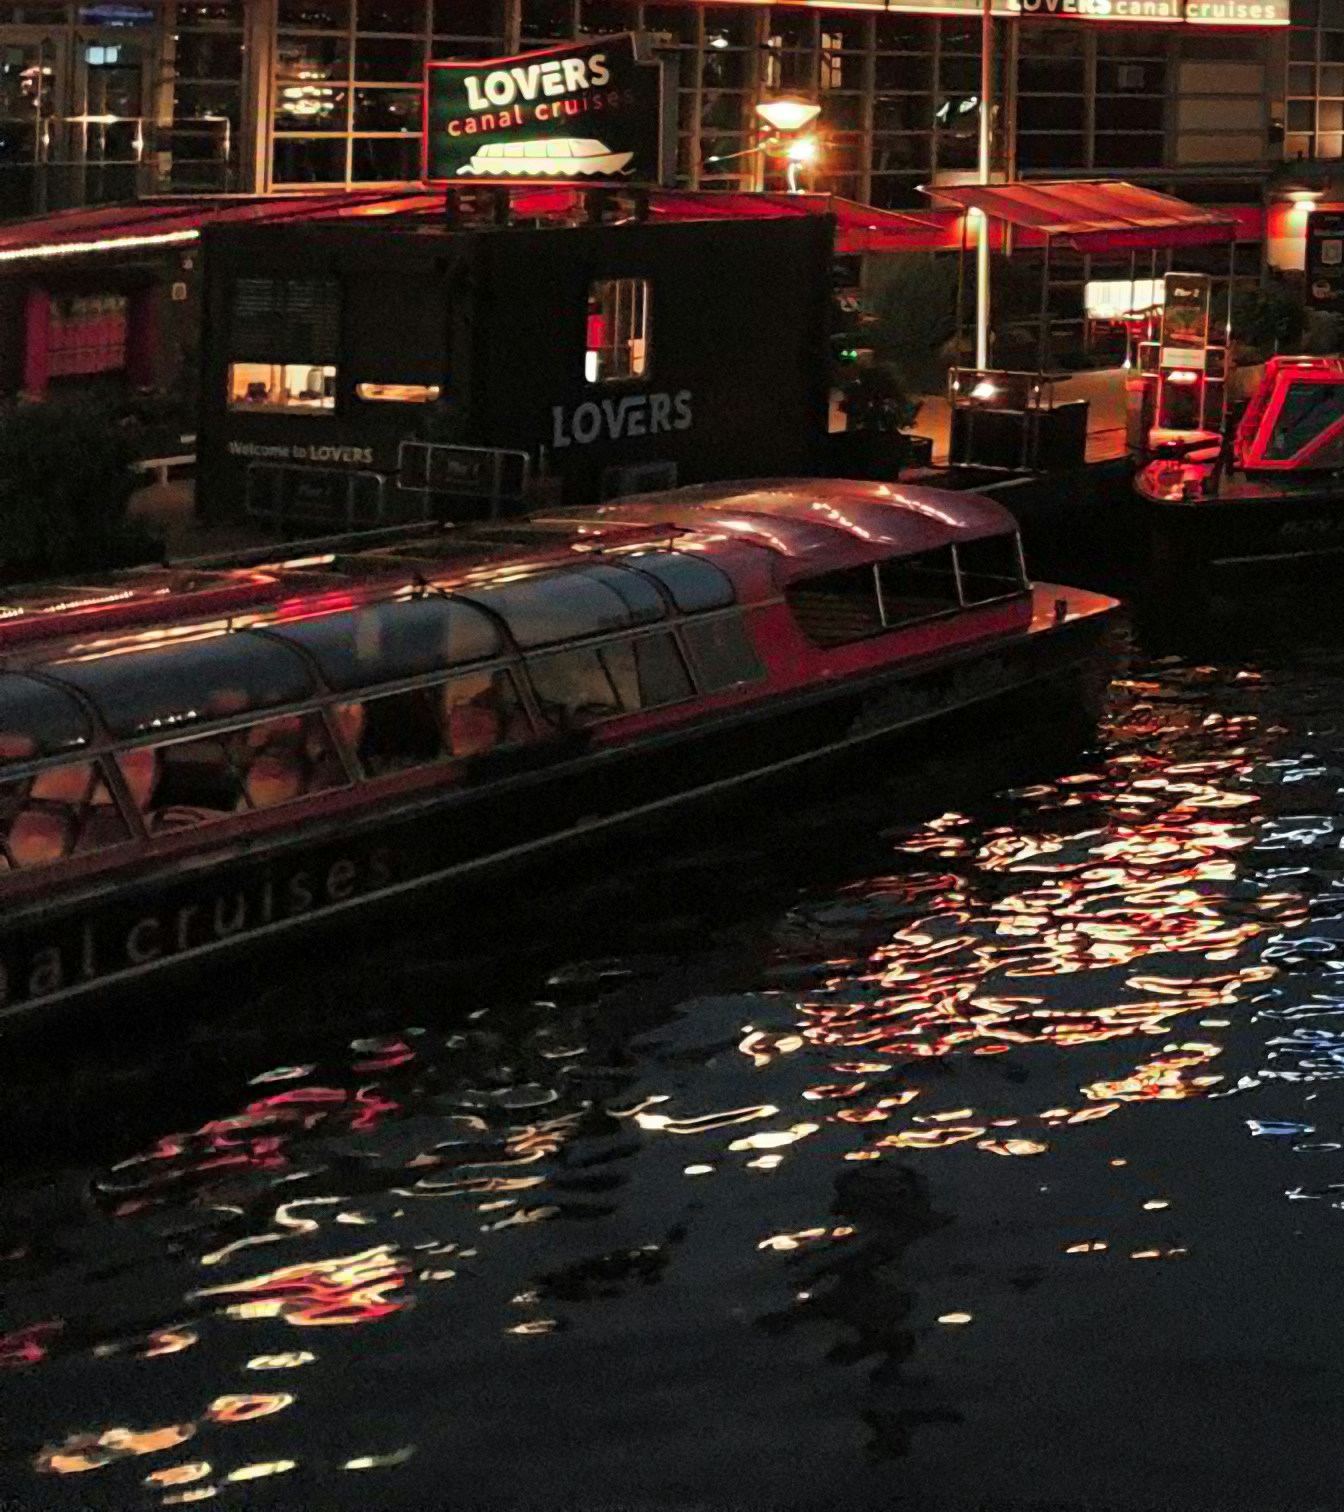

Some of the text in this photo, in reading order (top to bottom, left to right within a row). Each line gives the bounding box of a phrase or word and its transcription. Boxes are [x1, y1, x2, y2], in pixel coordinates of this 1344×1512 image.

[1186, 0, 1276, 20] cruises
[463, 53, 611, 111] LOVERS
[447, 88, 635, 137] canal cruises
[551, 388, 693, 449] LOVERS
[309, 445, 374, 464] LOVERS
[0, 847, 393, 1001] al cruises
